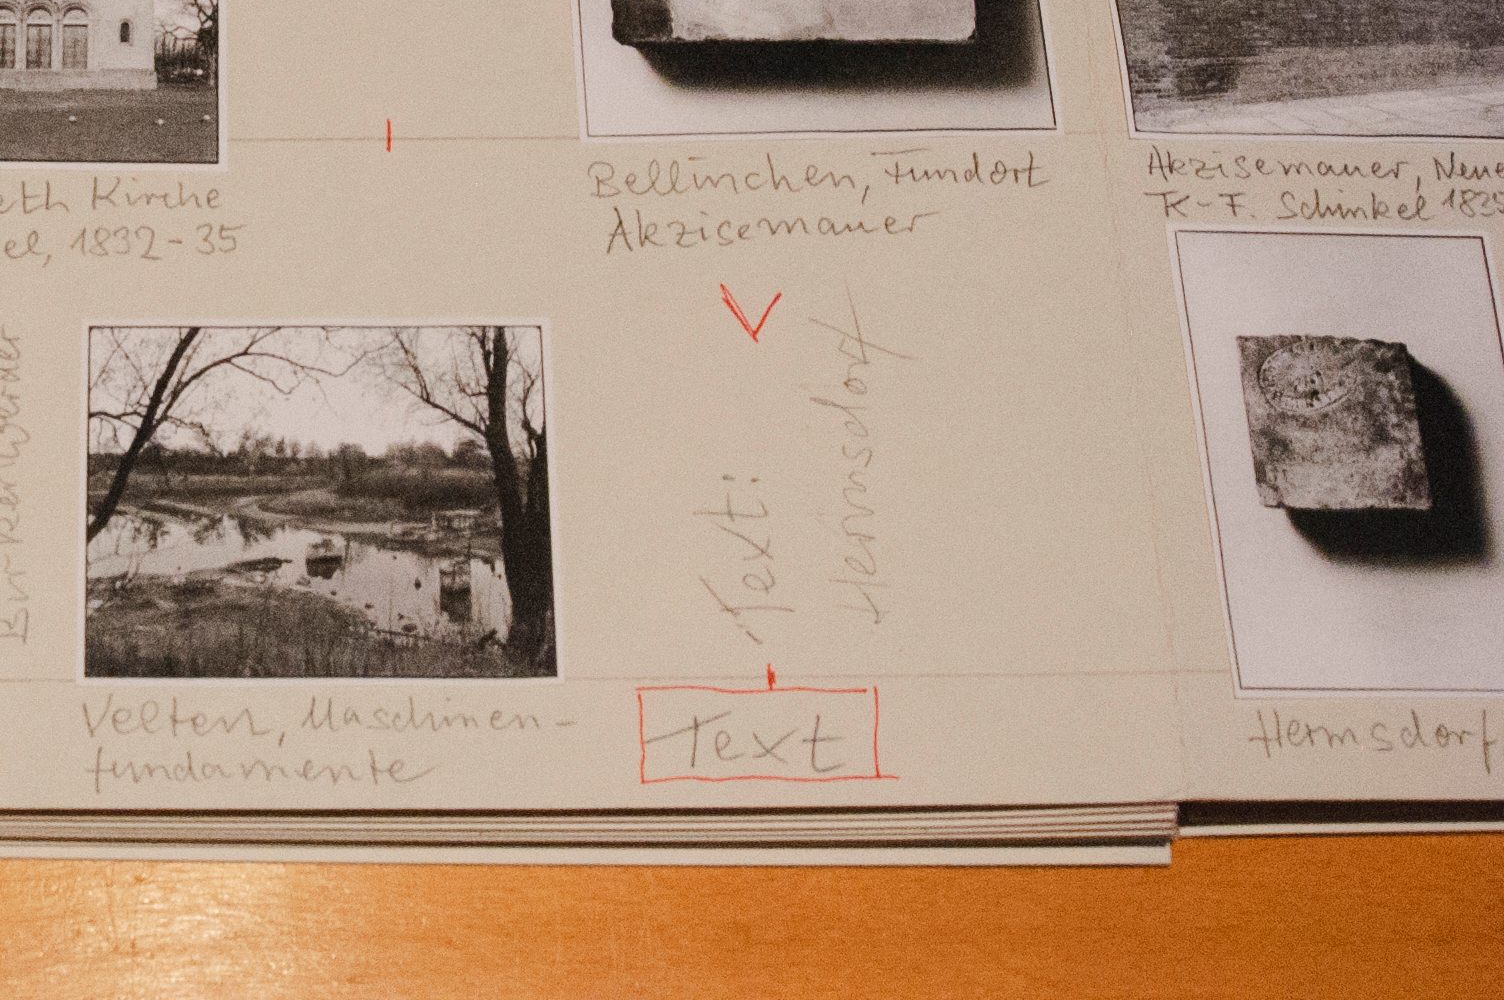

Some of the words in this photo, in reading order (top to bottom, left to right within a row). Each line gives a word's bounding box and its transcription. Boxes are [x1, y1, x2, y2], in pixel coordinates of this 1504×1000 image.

[90, 176, 221, 208] Kirche
[871, 147, 1052, 188] Fundort
[1276, 188, 1437, 221] Schinkel
[691, 473, 795, 645] Text:
[642, 711, 844, 774] Text
[1248, 709, 1498, 775] Hermsdorf
